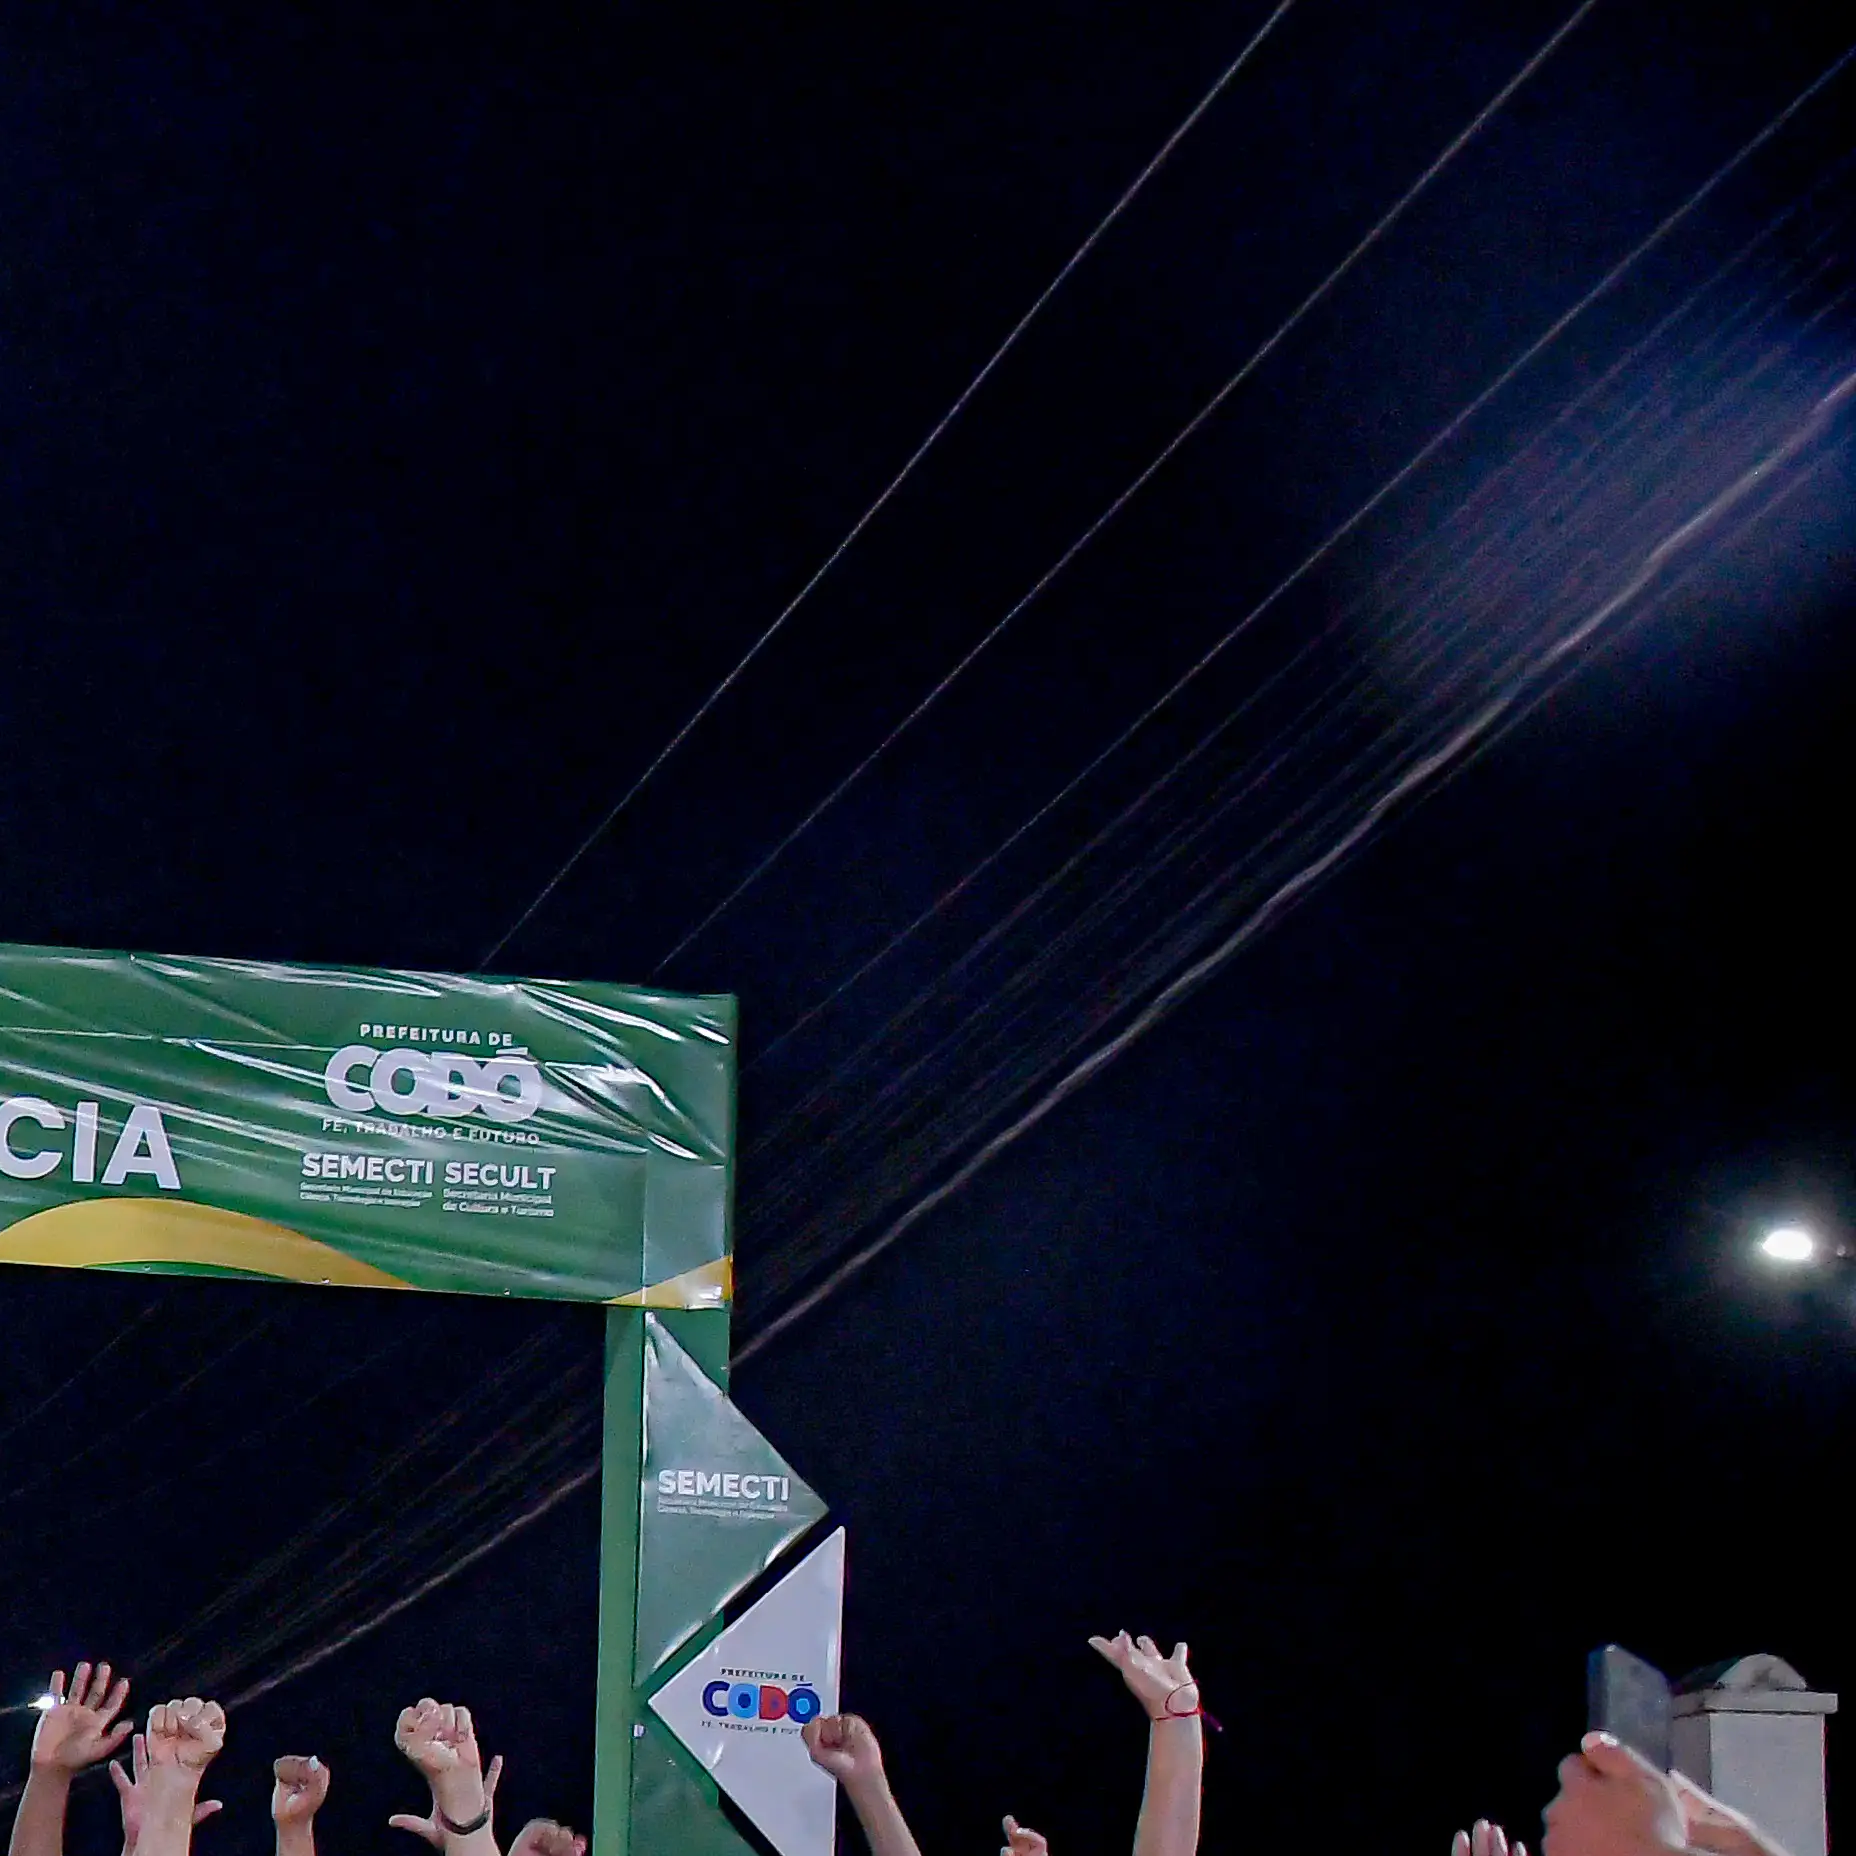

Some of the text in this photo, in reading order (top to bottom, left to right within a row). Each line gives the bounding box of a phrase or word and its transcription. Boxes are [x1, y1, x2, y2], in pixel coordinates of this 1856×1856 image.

[360, 1024, 514, 1047] PREFEITURA DE
[324, 1045, 543, 1123] CODÓ
[301, 1152, 557, 1190] SEMECTI SECULT
[658, 1469, 789, 1501] SEMECTI
[701, 1680, 821, 1725] CODÓ
